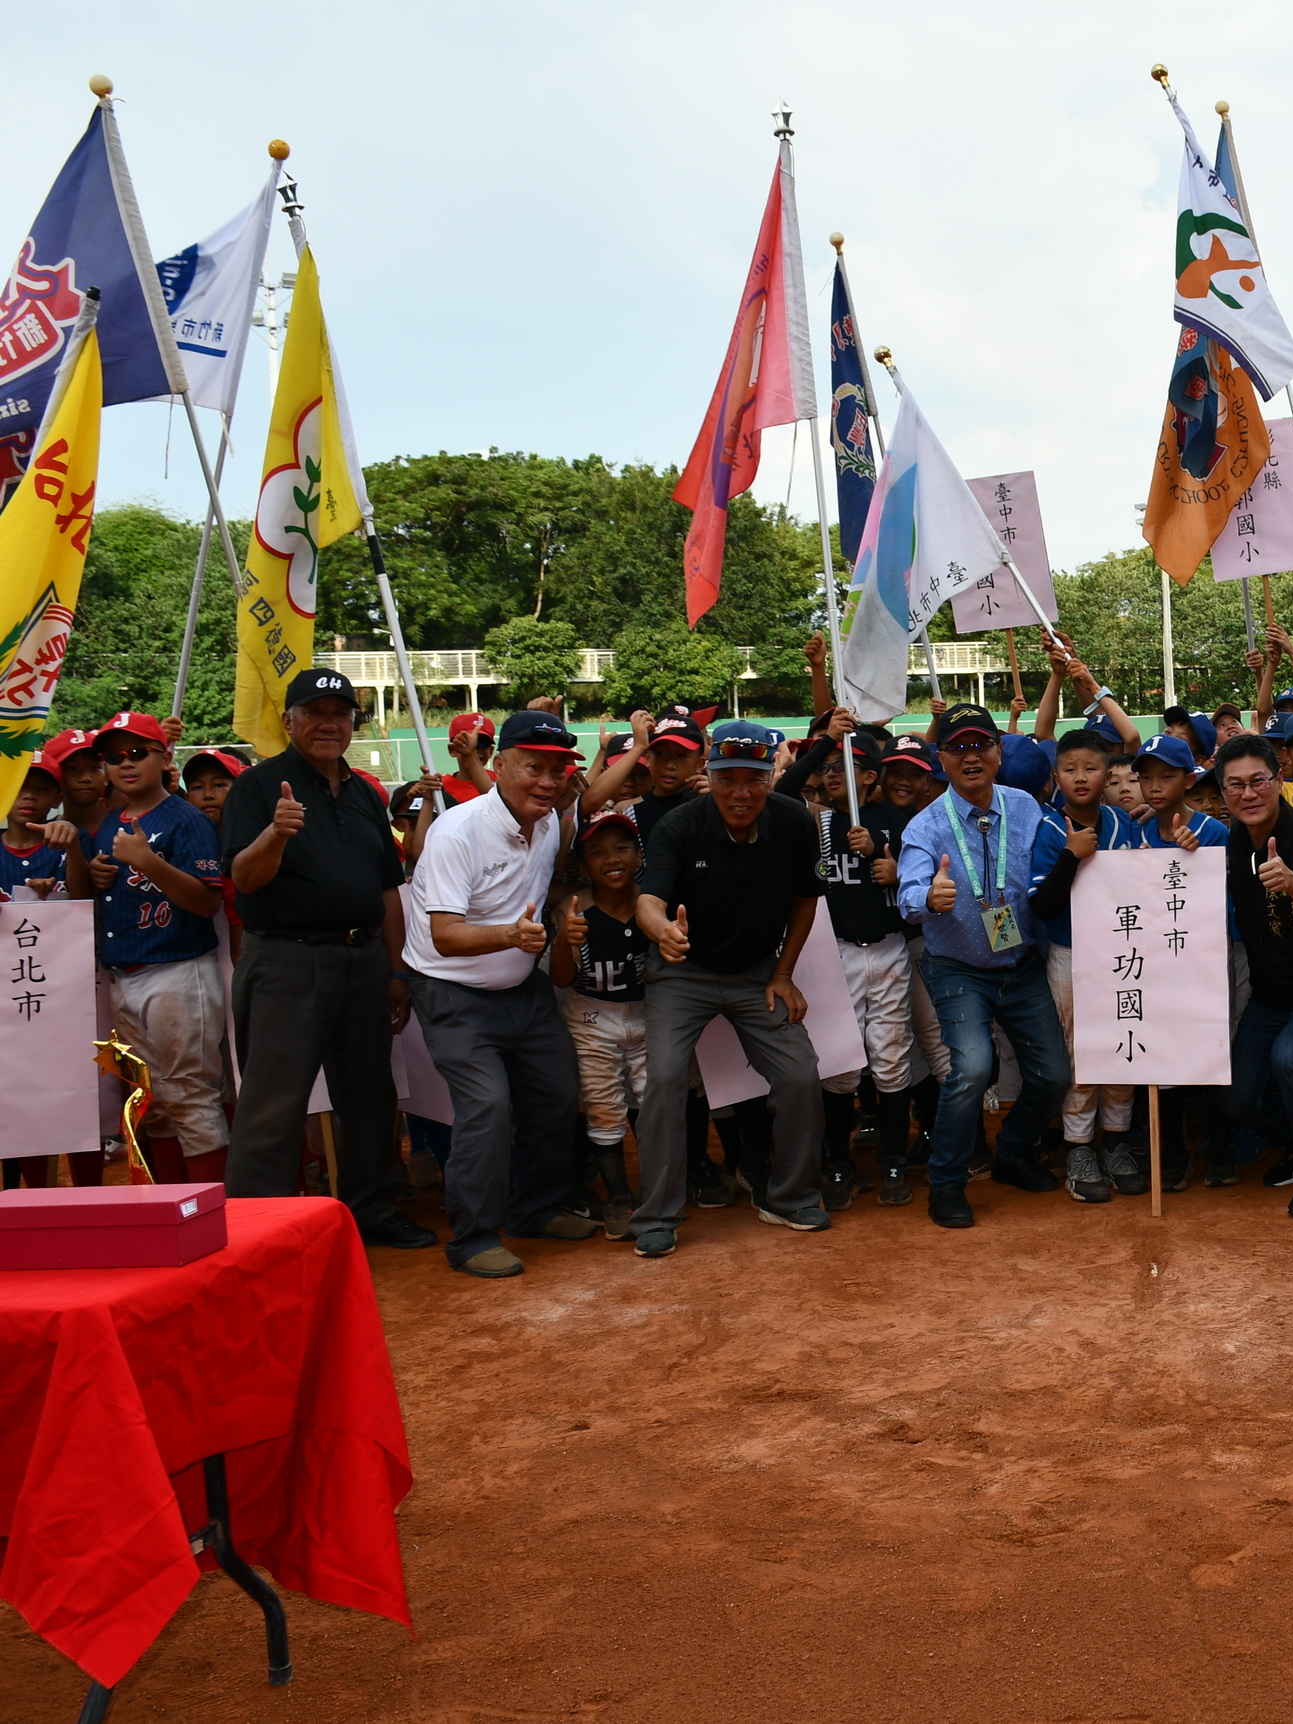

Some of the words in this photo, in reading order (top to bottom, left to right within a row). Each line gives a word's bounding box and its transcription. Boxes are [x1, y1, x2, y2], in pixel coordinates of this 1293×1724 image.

[994, 481, 1017, 545] 臺中市
[316, 676, 343, 690] CH
[113, 712, 131, 729] J
[70, 729, 86, 744] J
[1146, 736, 1164, 752] J
[138, 900, 172, 928] 10
[1162, 859, 1189, 957] 臺中市
[11, 917, 47, 1022] 台北市
[1112, 904, 1147, 1063] 軍功國小
